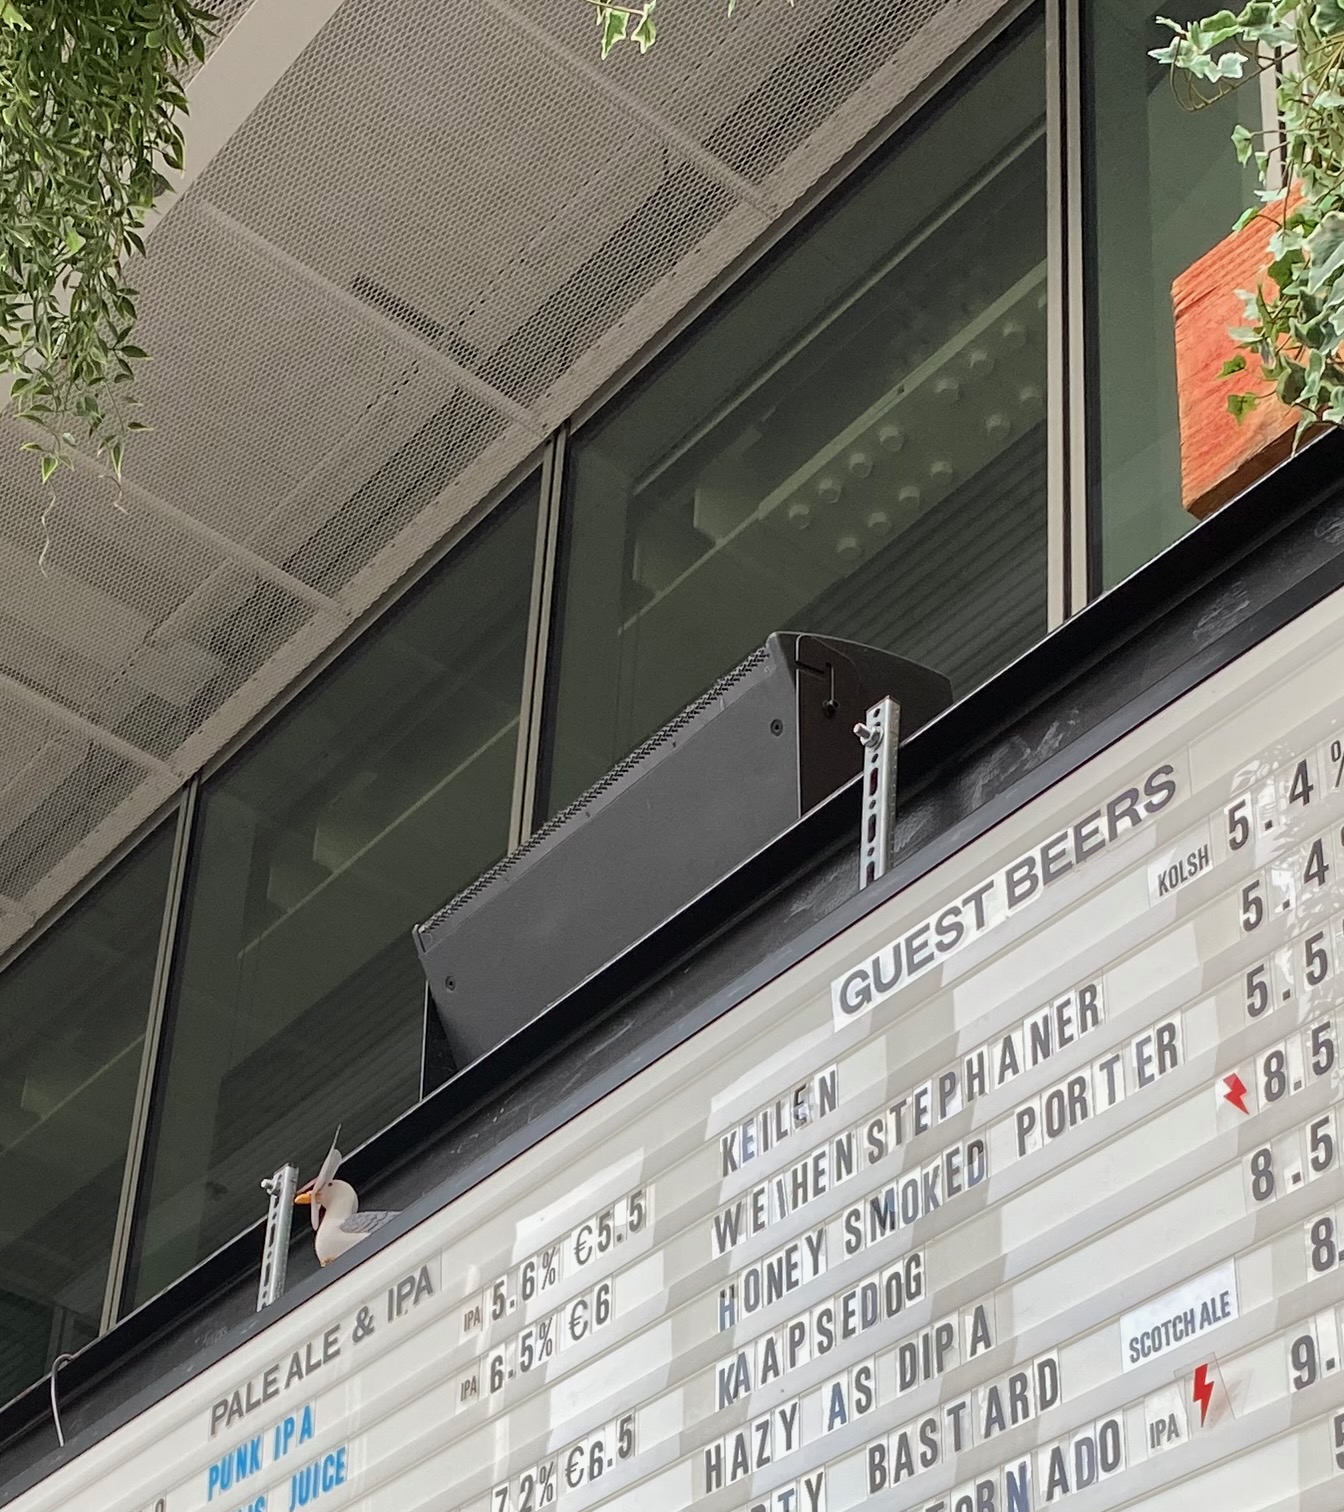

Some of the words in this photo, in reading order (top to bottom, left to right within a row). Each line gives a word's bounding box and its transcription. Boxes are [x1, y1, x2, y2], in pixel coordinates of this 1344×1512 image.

[839, 880, 995, 1016] GUEST
[1005, 764, 1177, 911] BEERS
[721, 1067, 839, 1178] KEILEN
[1157, 844, 1210, 896] KOLSH
[713, 982, 1100, 1254] WEIHENSTEPHANER
[718, 1227, 826, 1332] HONEY
[844, 1138, 986, 1255] SMOKED
[1016, 1021, 1180, 1159] PORTER
[208, 1433, 263, 1502] PUNK
[273, 1405, 313, 1461] IPA
[463, 1306, 481, 1333] IPA
[492, 1247, 556, 1321] 5.6%
[574, 1189, 645, 1266] €5.5
[210, 1363, 280, 1438] PALE
[284, 1323, 341, 1390] ALE
[352, 1305, 375, 1344] &
[386, 1264, 434, 1325] IPA
[460, 1375, 477, 1402] IPA
[489, 1316, 554, 1394] 6.5%
[568, 1282, 611, 1342] €6
[705, 1401, 798, 1494] HAZY
[827, 1365, 873, 1432] AS
[898, 1304, 993, 1392] DIPA
[868, 1357, 1058, 1494] BASTARD
[1129, 1308, 1196, 1363] SCOTCH
[1199, 1290, 1231, 1331] ALE
[1150, 1413, 1180, 1449] IPA
[564, 1414, 633, 1488] €6.5
